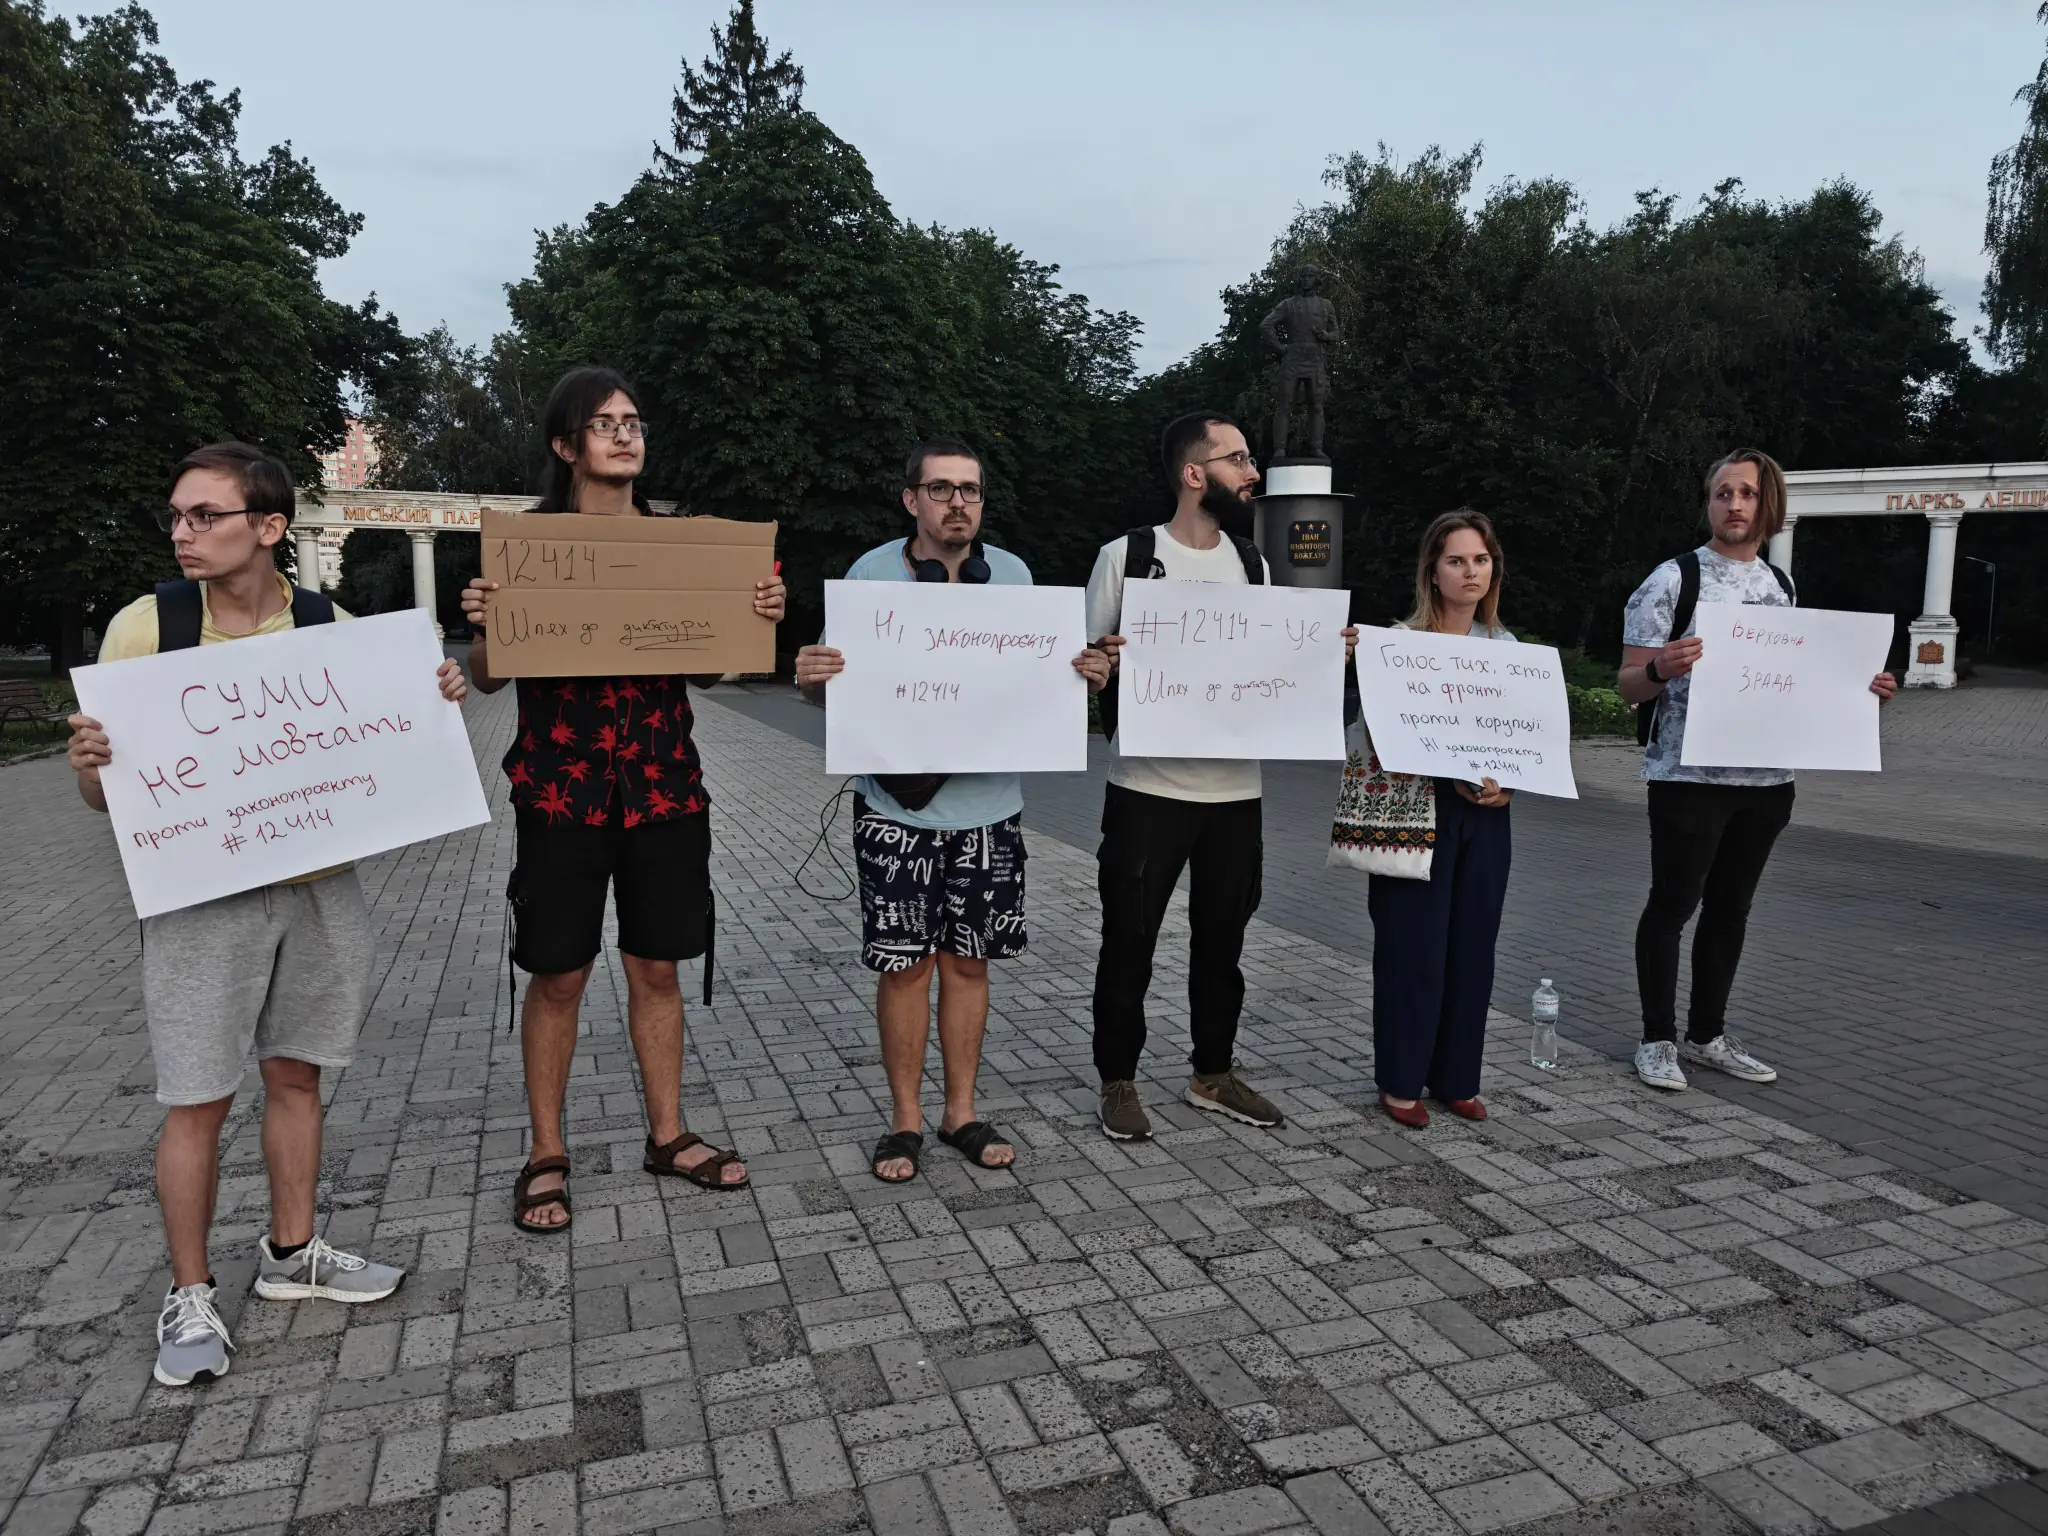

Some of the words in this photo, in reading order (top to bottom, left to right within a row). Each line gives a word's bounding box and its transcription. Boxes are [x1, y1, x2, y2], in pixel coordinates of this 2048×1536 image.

[1886, 492, 1966, 511] ПАРКЪ
[343, 506, 432, 523] МІСЬКИЙ
[442, 509, 481, 525] ПАР
[496, 540, 596, 585] 12414
[580, 622, 599, 645] до
[1131, 608, 1249, 645] #12414
[1380, 643, 1442, 672] Голос
[1506, 663, 1551, 680] хто
[896, 680, 960, 702] #12414
[1205, 682, 1222, 702] до
[1230, 677, 1297, 702] диктатури
[1407, 681, 1431, 695] на
[181, 667, 348, 735] СУМИ
[1399, 712, 1460, 730] проти
[133, 816, 209, 850] проти
